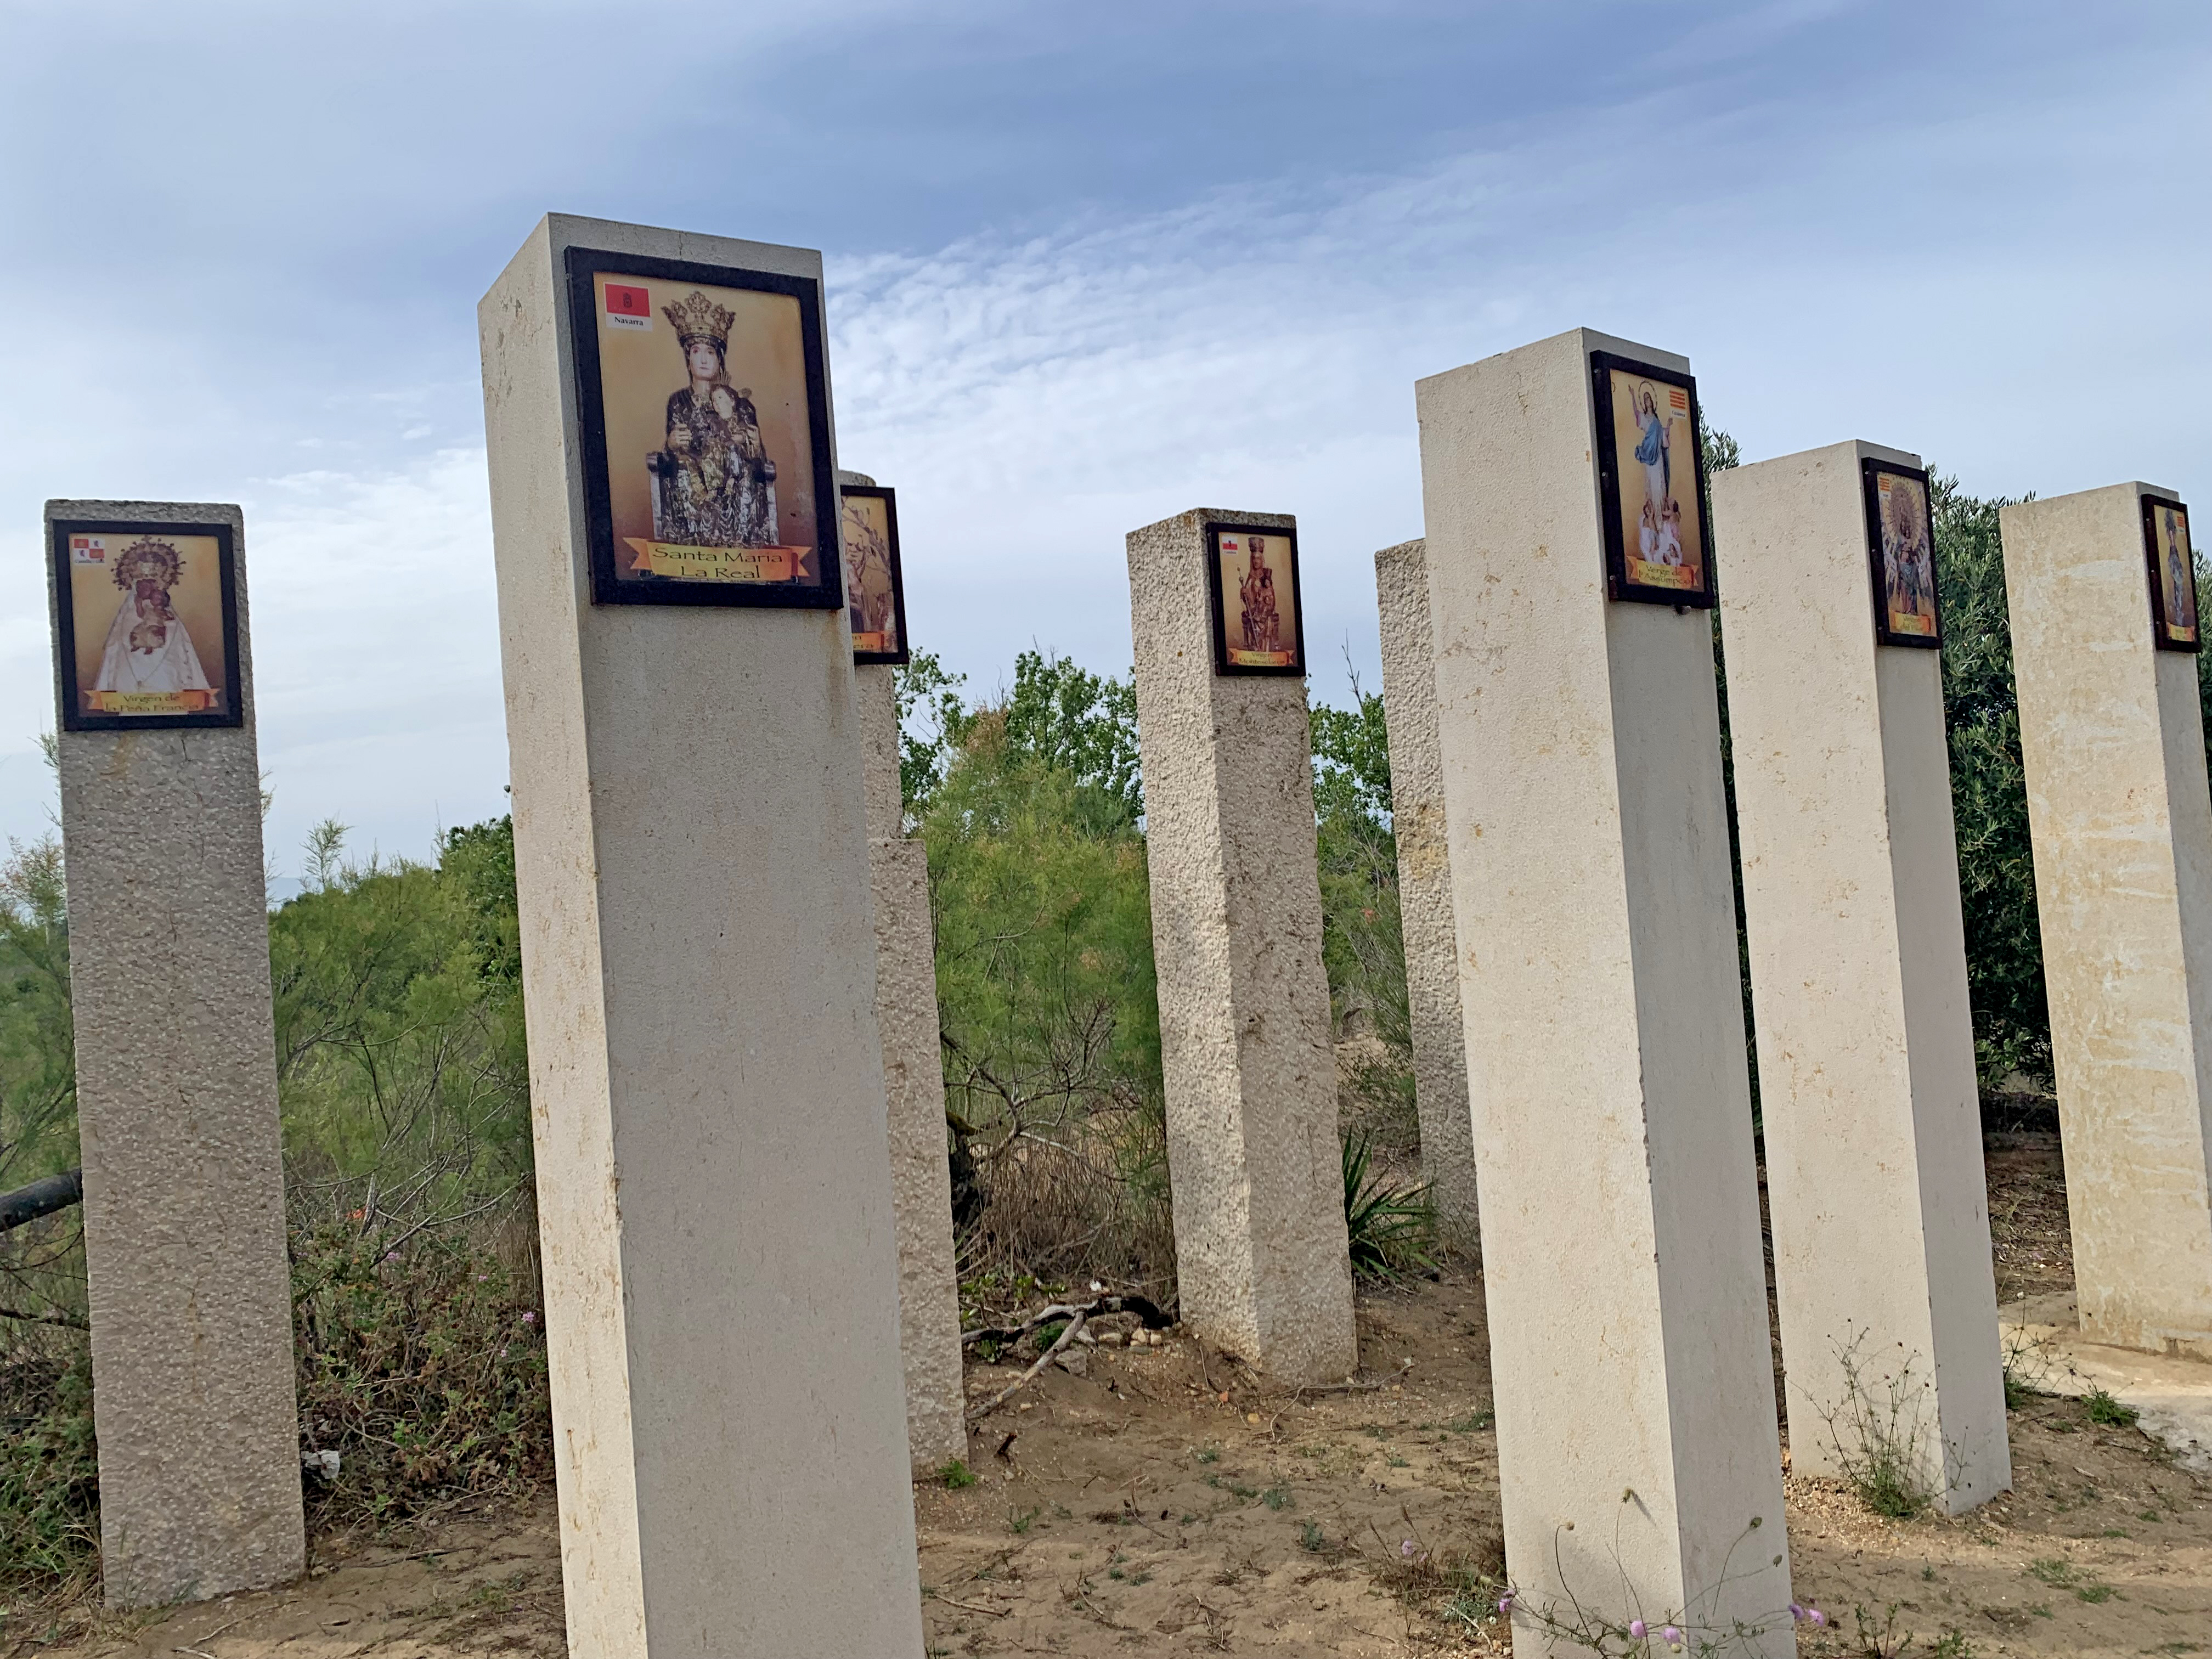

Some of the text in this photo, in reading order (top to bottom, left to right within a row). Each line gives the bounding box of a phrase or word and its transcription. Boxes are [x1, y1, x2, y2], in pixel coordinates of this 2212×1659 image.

[614, 316, 644, 326] Navarra
[652, 548, 718, 562] Santa
[681, 565, 760, 578] La Real
[1645, 565, 1683, 576] Verge de
[123, 692, 180, 703] Virgen de
[105, 703, 116, 712] la
